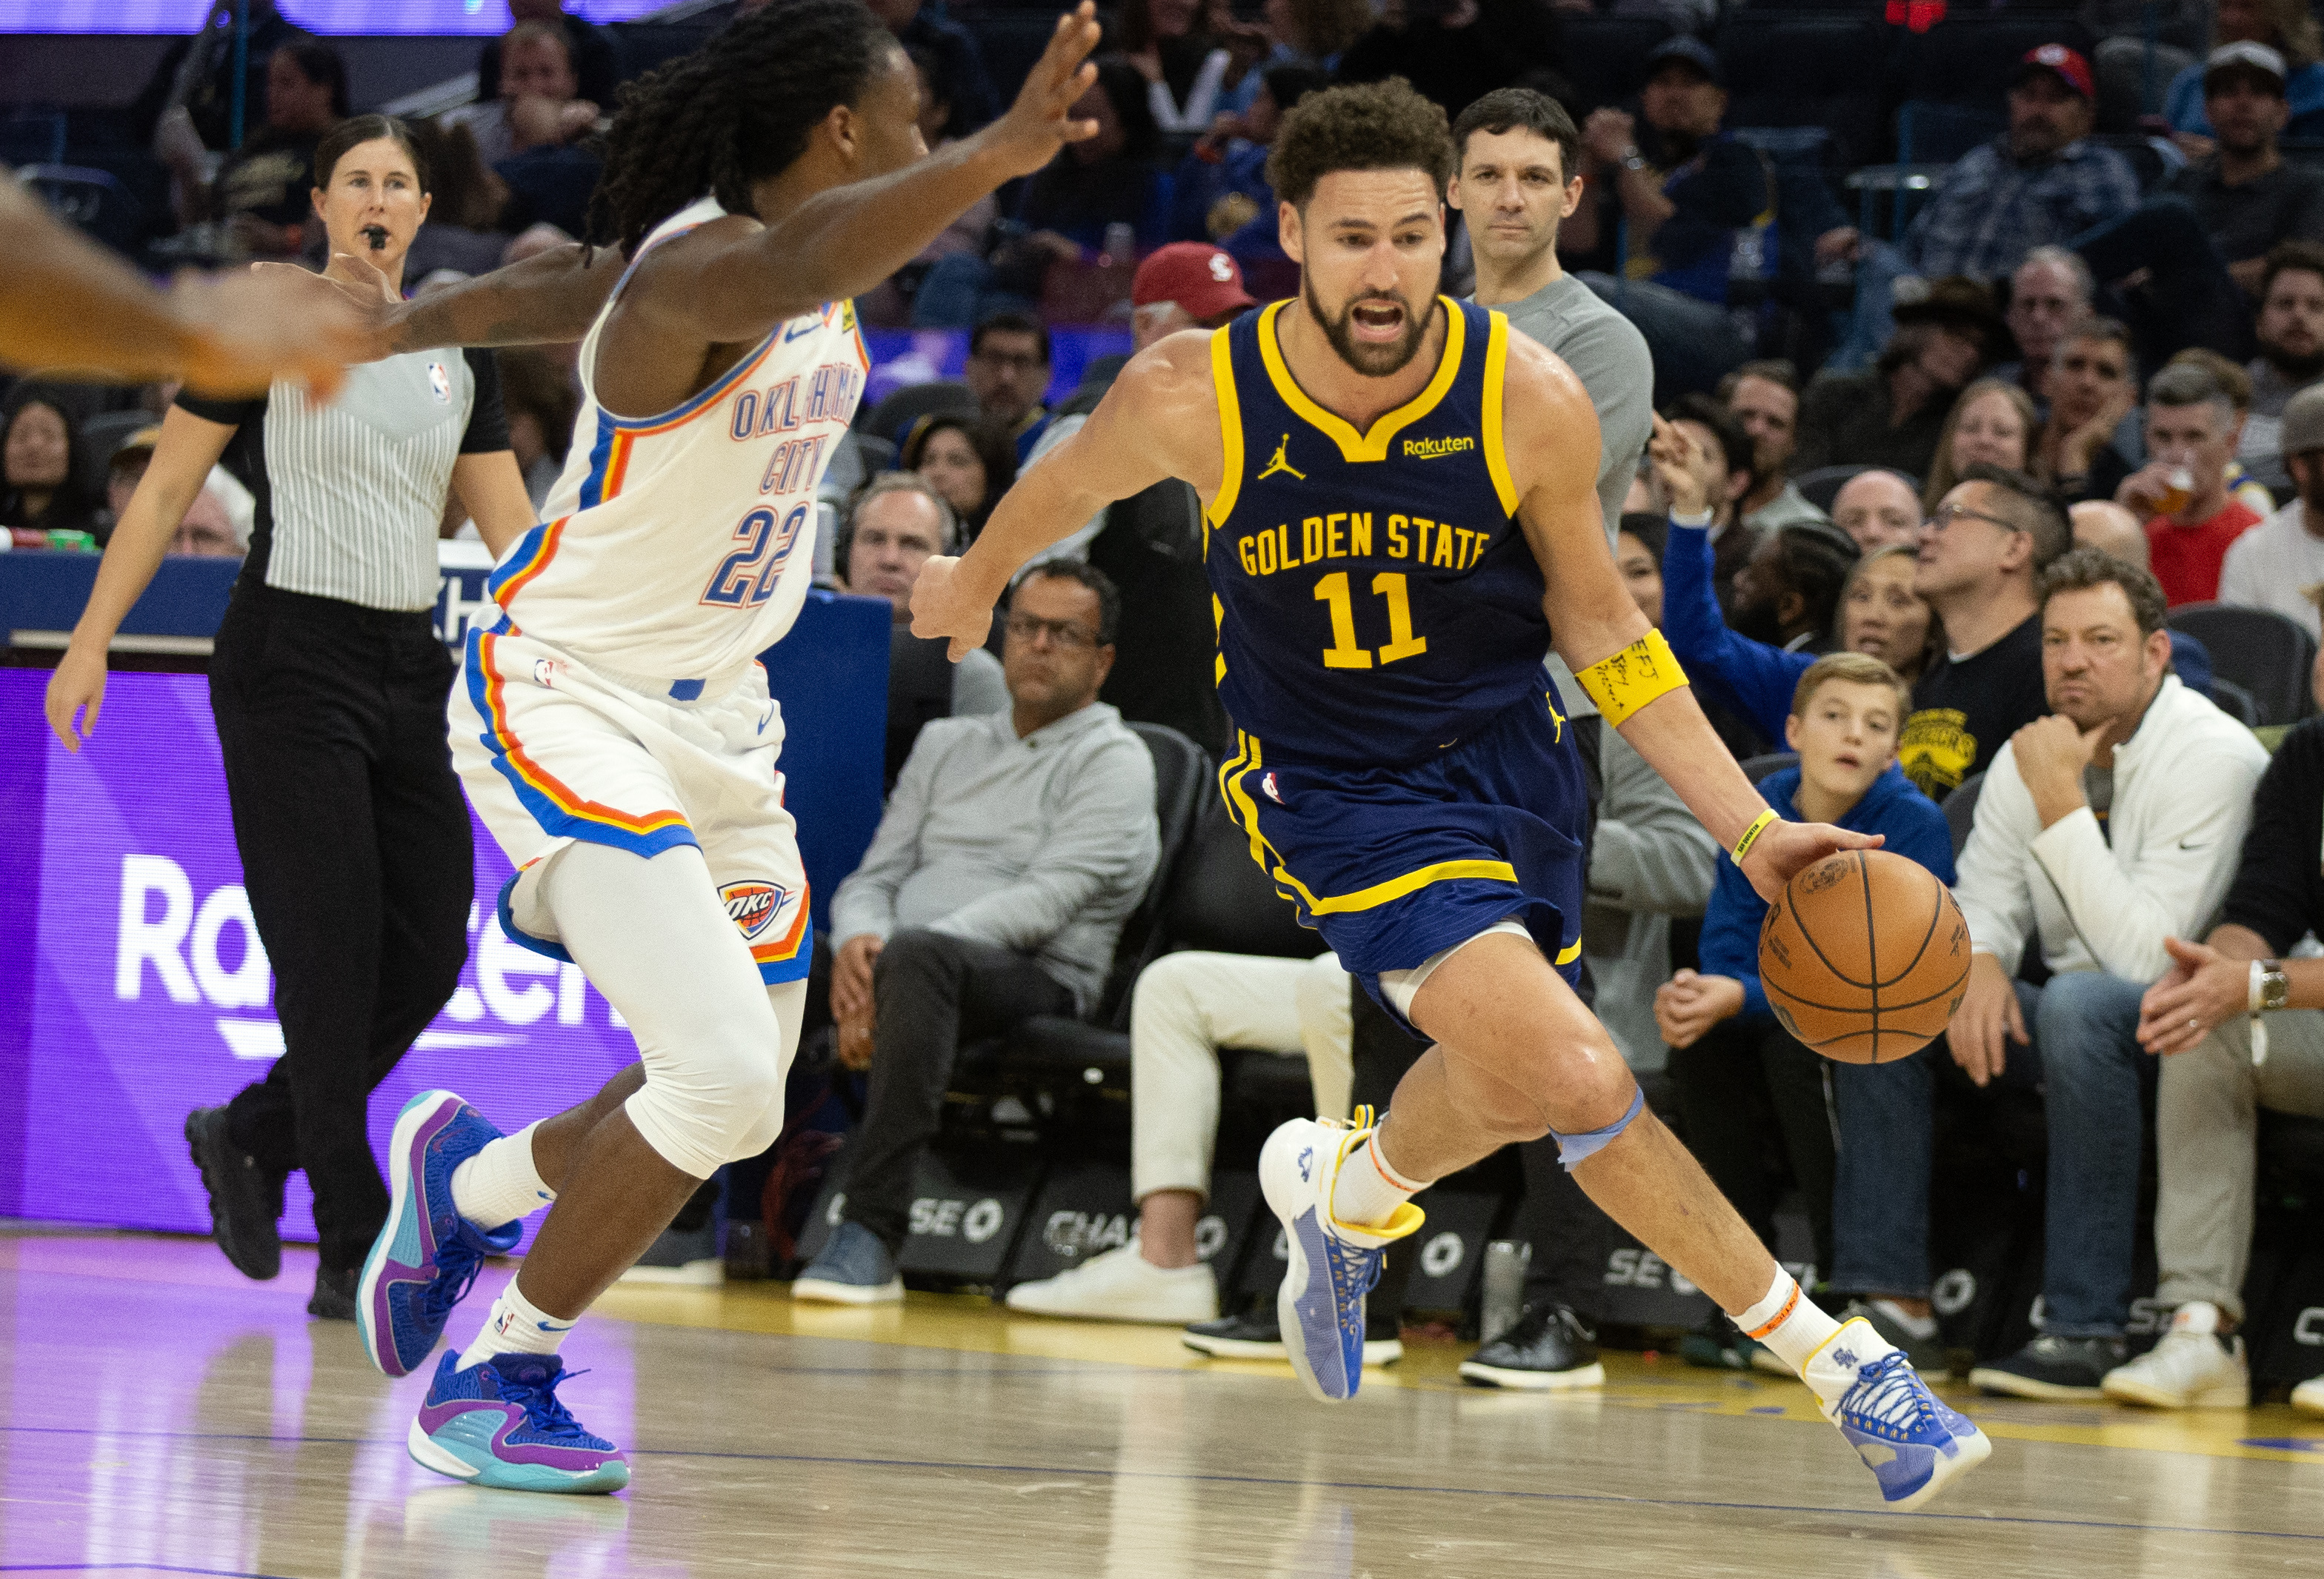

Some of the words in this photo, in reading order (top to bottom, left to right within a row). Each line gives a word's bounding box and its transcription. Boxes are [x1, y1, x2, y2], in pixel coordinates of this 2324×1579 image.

[759, 433, 829, 495] CITY
[1403, 436, 1474, 456] Rakuten
[698, 501, 810, 610] 22
[1238, 512, 1372, 576] GOLDEN
[1387, 513, 1491, 570] STATE
[1314, 571, 1427, 669] 11
[1742, 823, 1760, 844] QUENTIN
[723, 891, 774, 919] OKC
[1042, 1209, 1142, 1257] CHA
